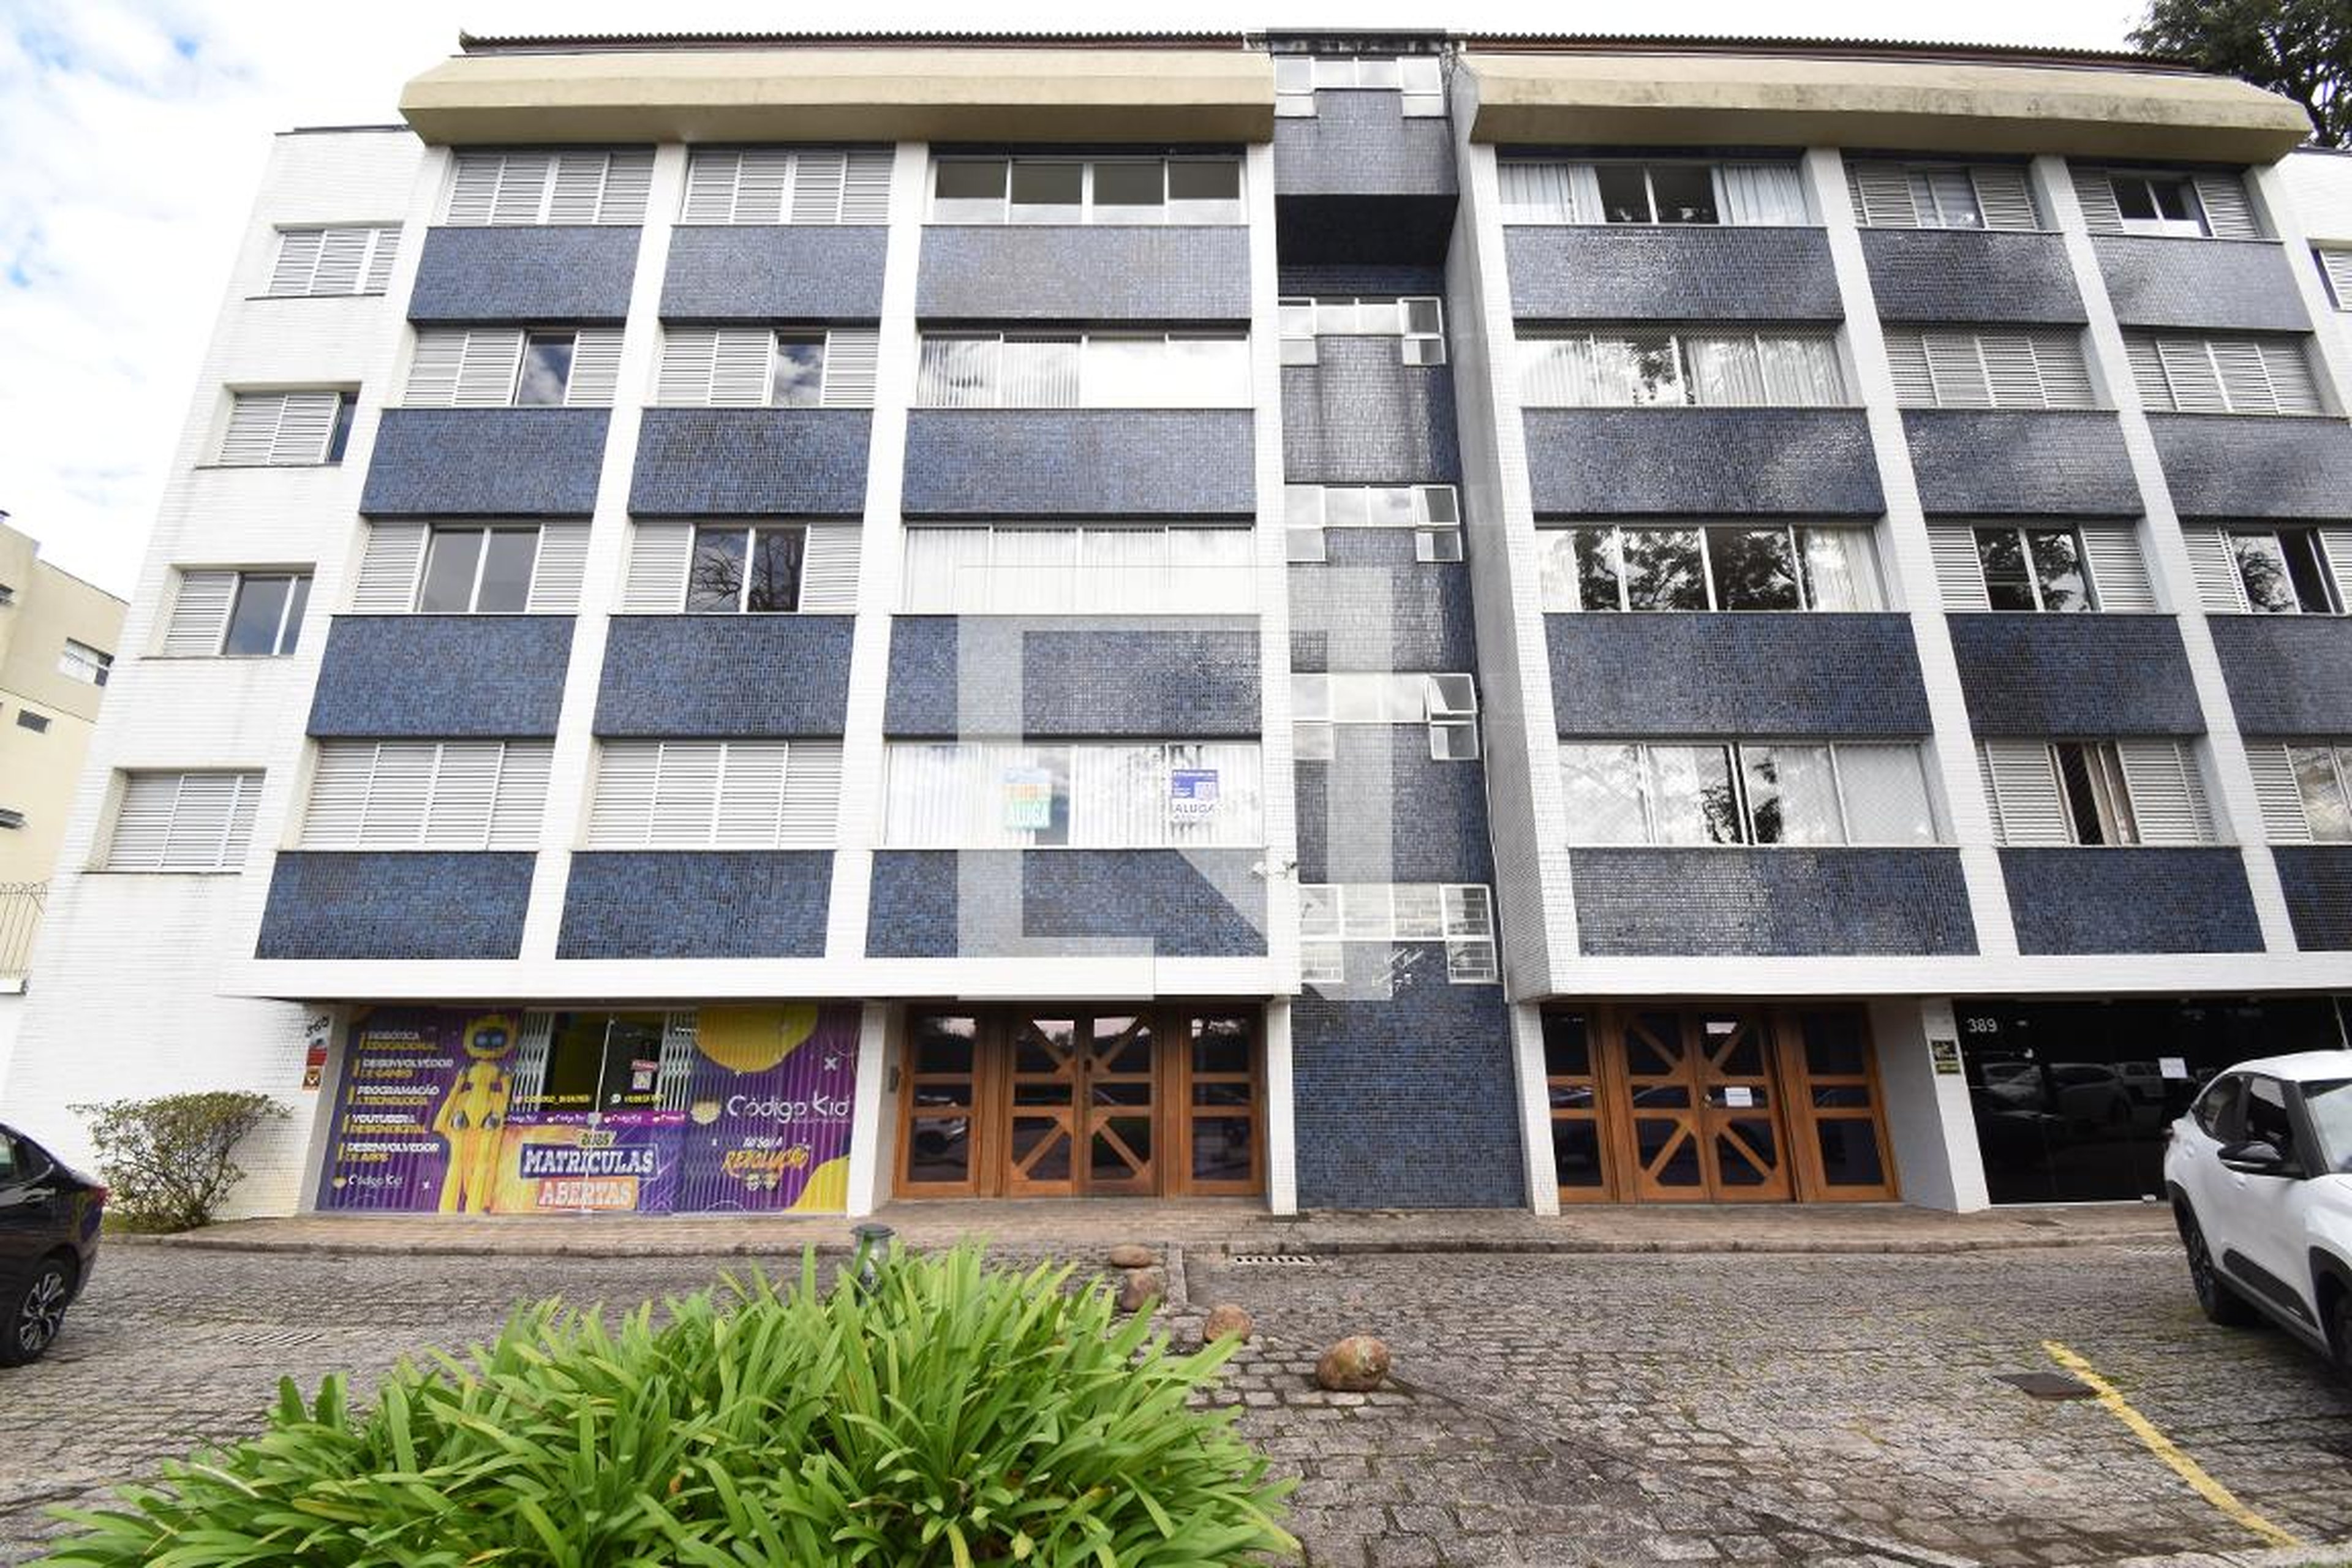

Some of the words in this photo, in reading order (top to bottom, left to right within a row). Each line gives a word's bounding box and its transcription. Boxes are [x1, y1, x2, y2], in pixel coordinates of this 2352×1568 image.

[1967, 1018, 1997, 1033] 389
[727, 1094, 807, 1123] Código
[812, 1091, 850, 1117] Kid
[347, 1142, 440, 1152] DESENVOLVEDOR
[538, 1180, 631, 1205] ABERTAS
